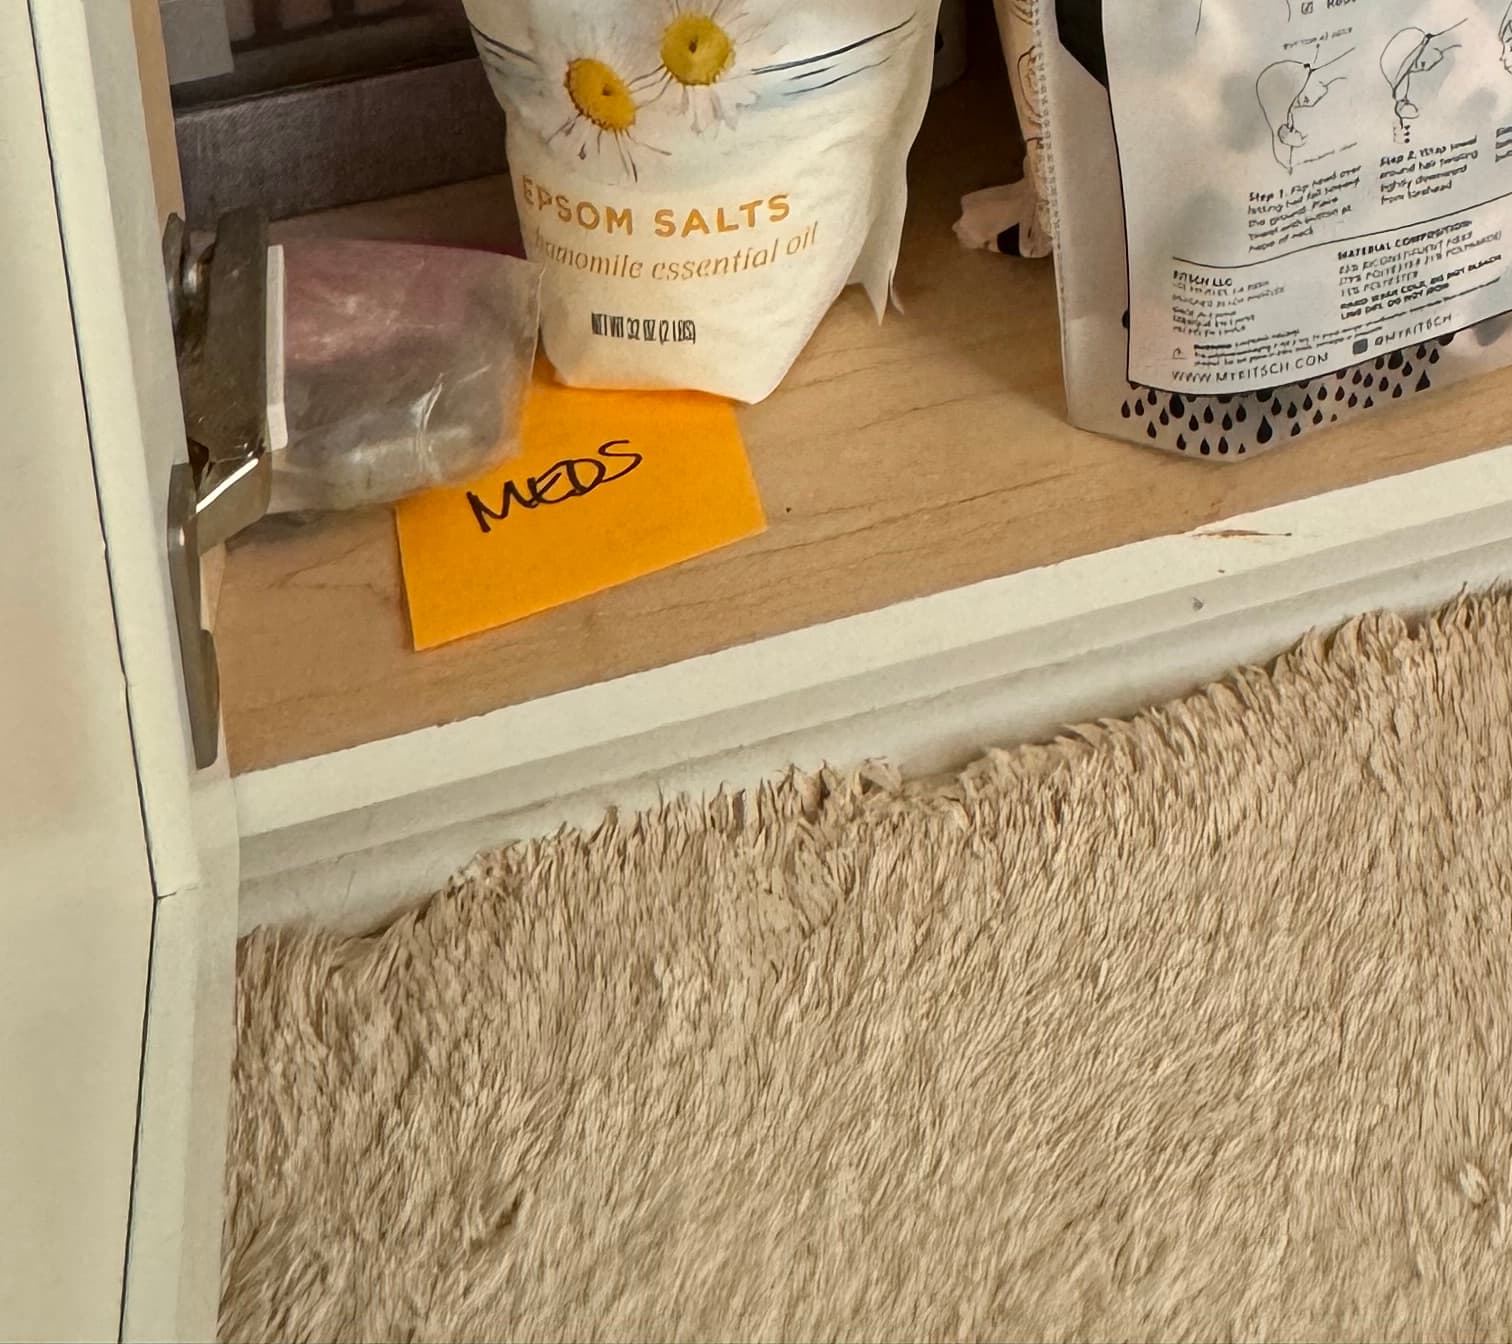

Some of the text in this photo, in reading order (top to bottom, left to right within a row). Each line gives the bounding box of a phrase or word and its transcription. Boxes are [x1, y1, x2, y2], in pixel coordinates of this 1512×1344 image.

[521, 174, 791, 239] EPSOM SALTS
[650, 238, 779, 282] essential
[786, 220, 820, 257] oil
[465, 438, 644, 534] MEDS
